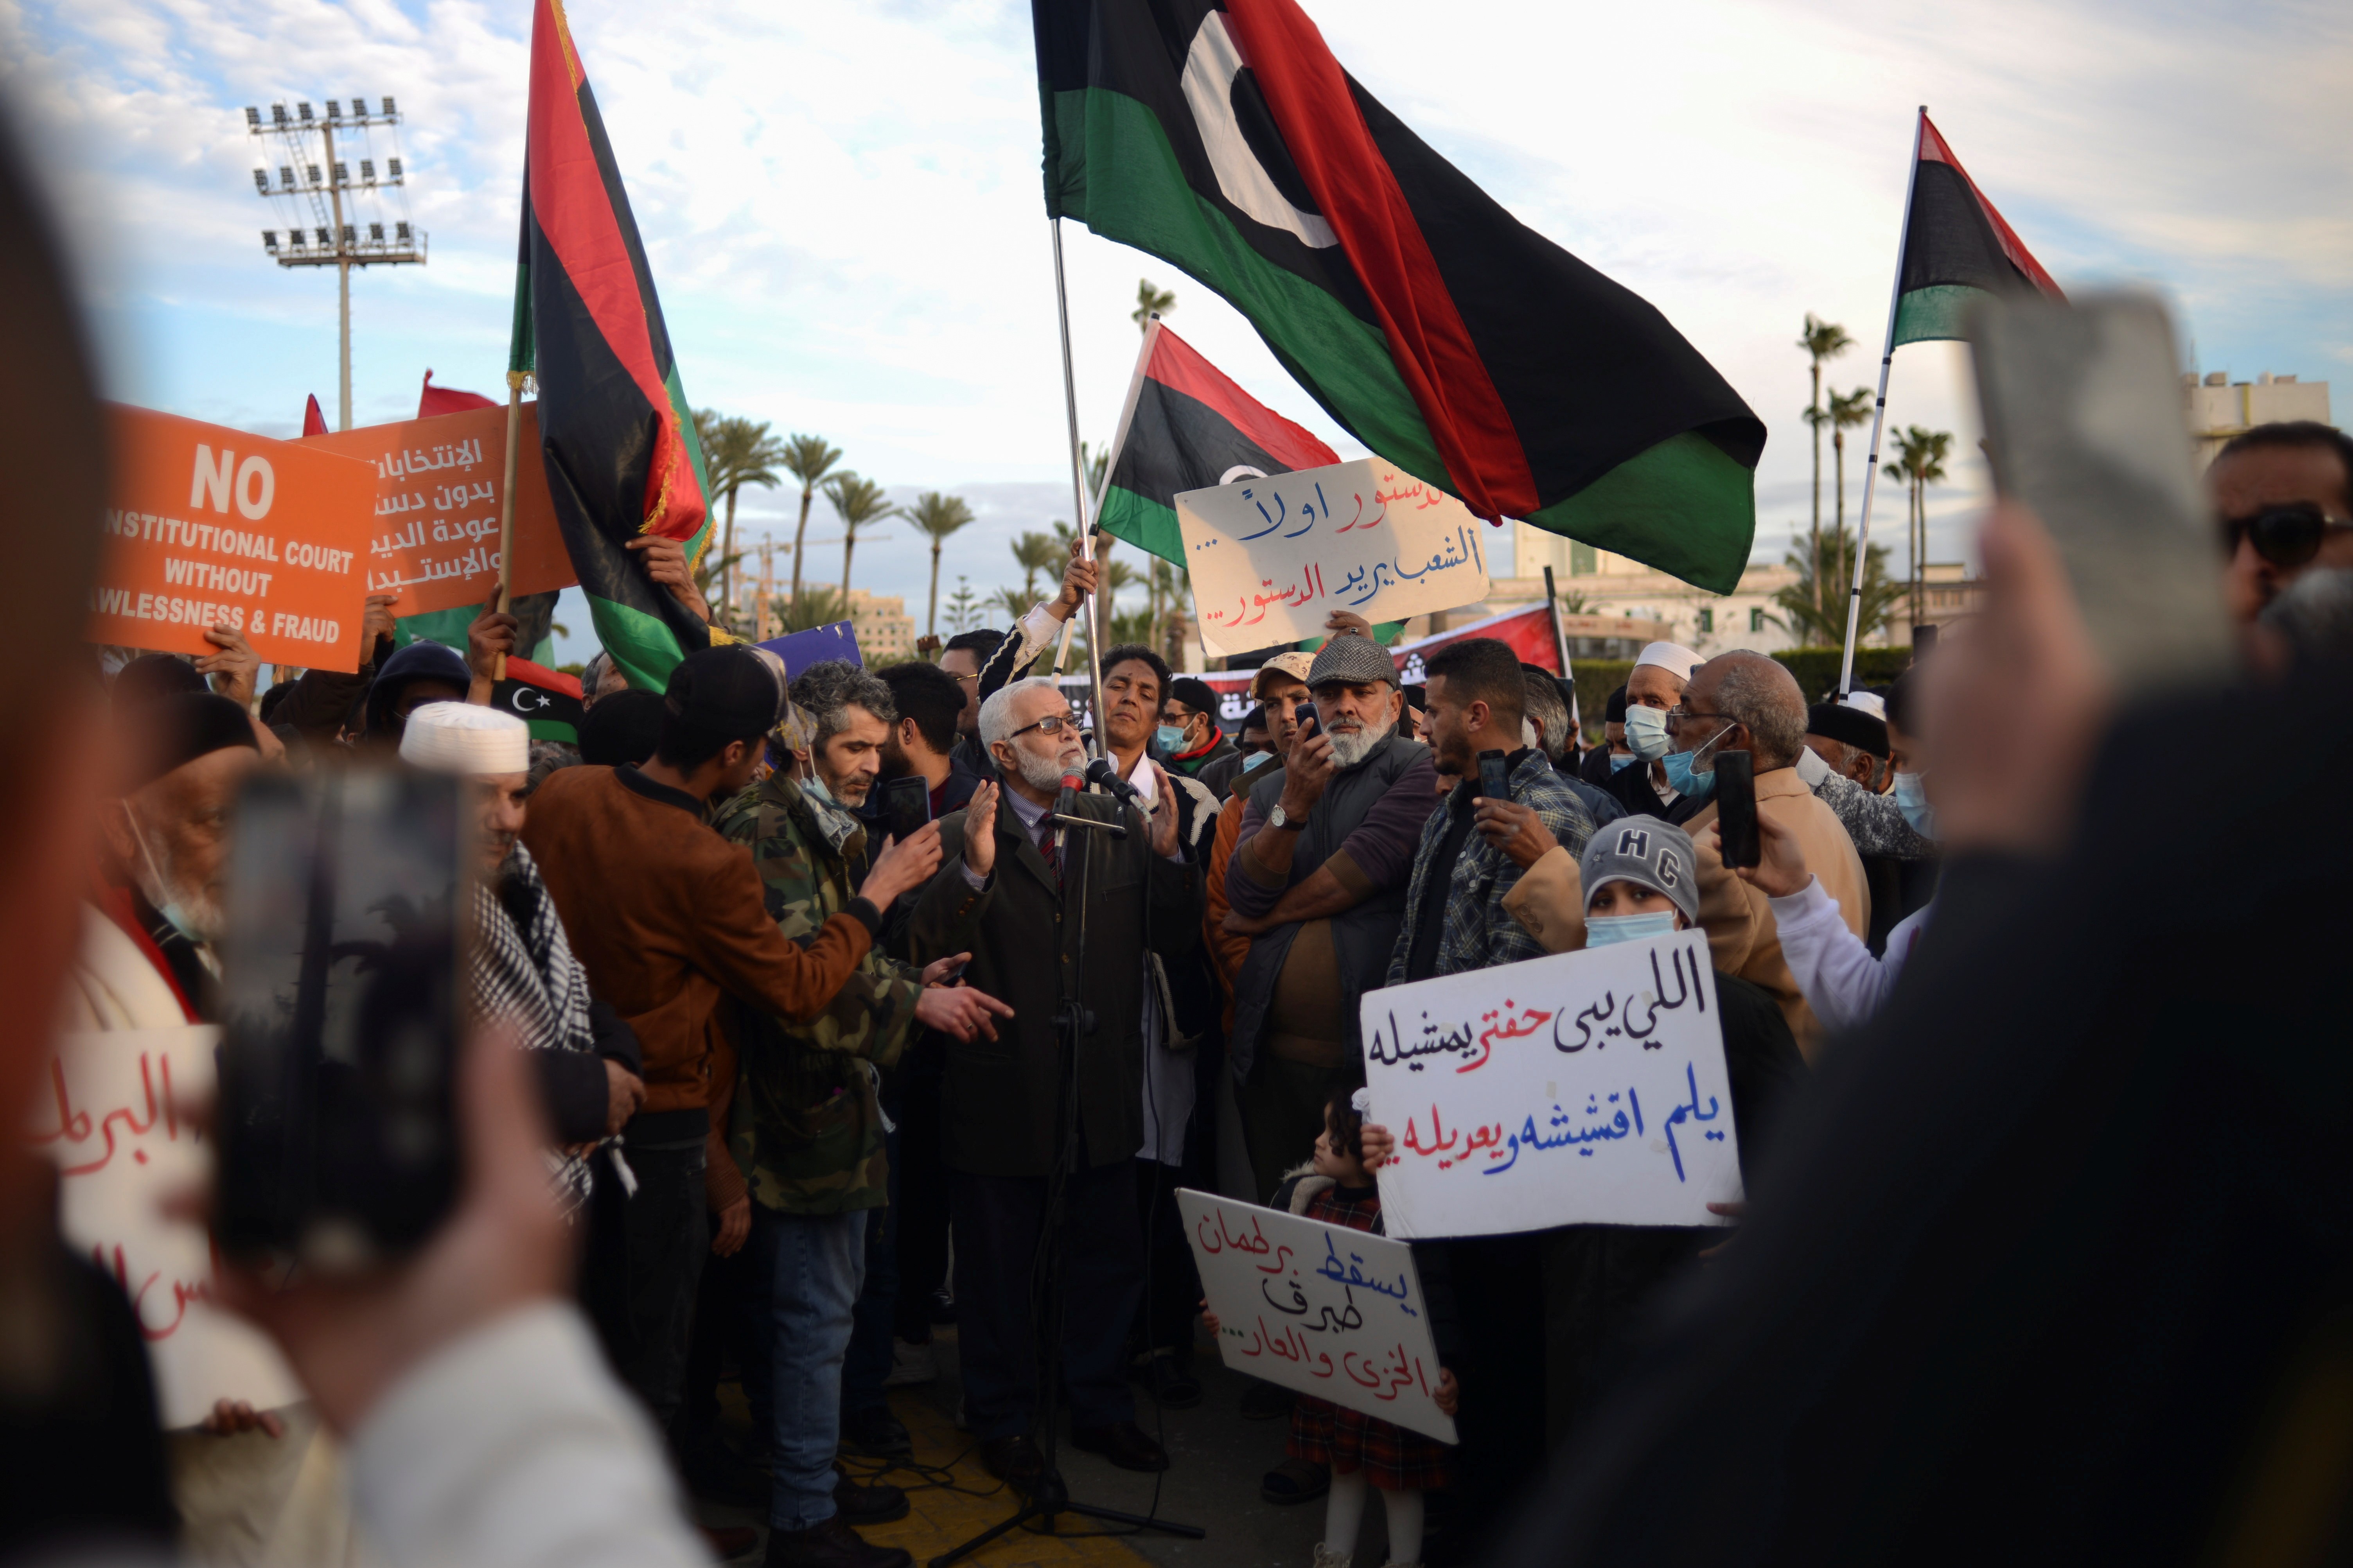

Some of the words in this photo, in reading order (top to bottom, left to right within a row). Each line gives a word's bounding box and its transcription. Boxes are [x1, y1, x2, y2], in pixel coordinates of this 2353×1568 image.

[190, 444, 274, 520] NO
[433, 481, 495, 511] بدون
[104, 508, 278, 562] NSTITUTIONAL
[285, 541, 353, 574] COURT
[433, 517, 499, 543] عودة
[165, 558, 272, 597] WITHOUT
[250, 610, 266, 634] &
[272, 613, 339, 644] FRAUD
[1455, 998, 1552, 1074] حفتر
[1663, 1061, 1724, 1183] يلم
